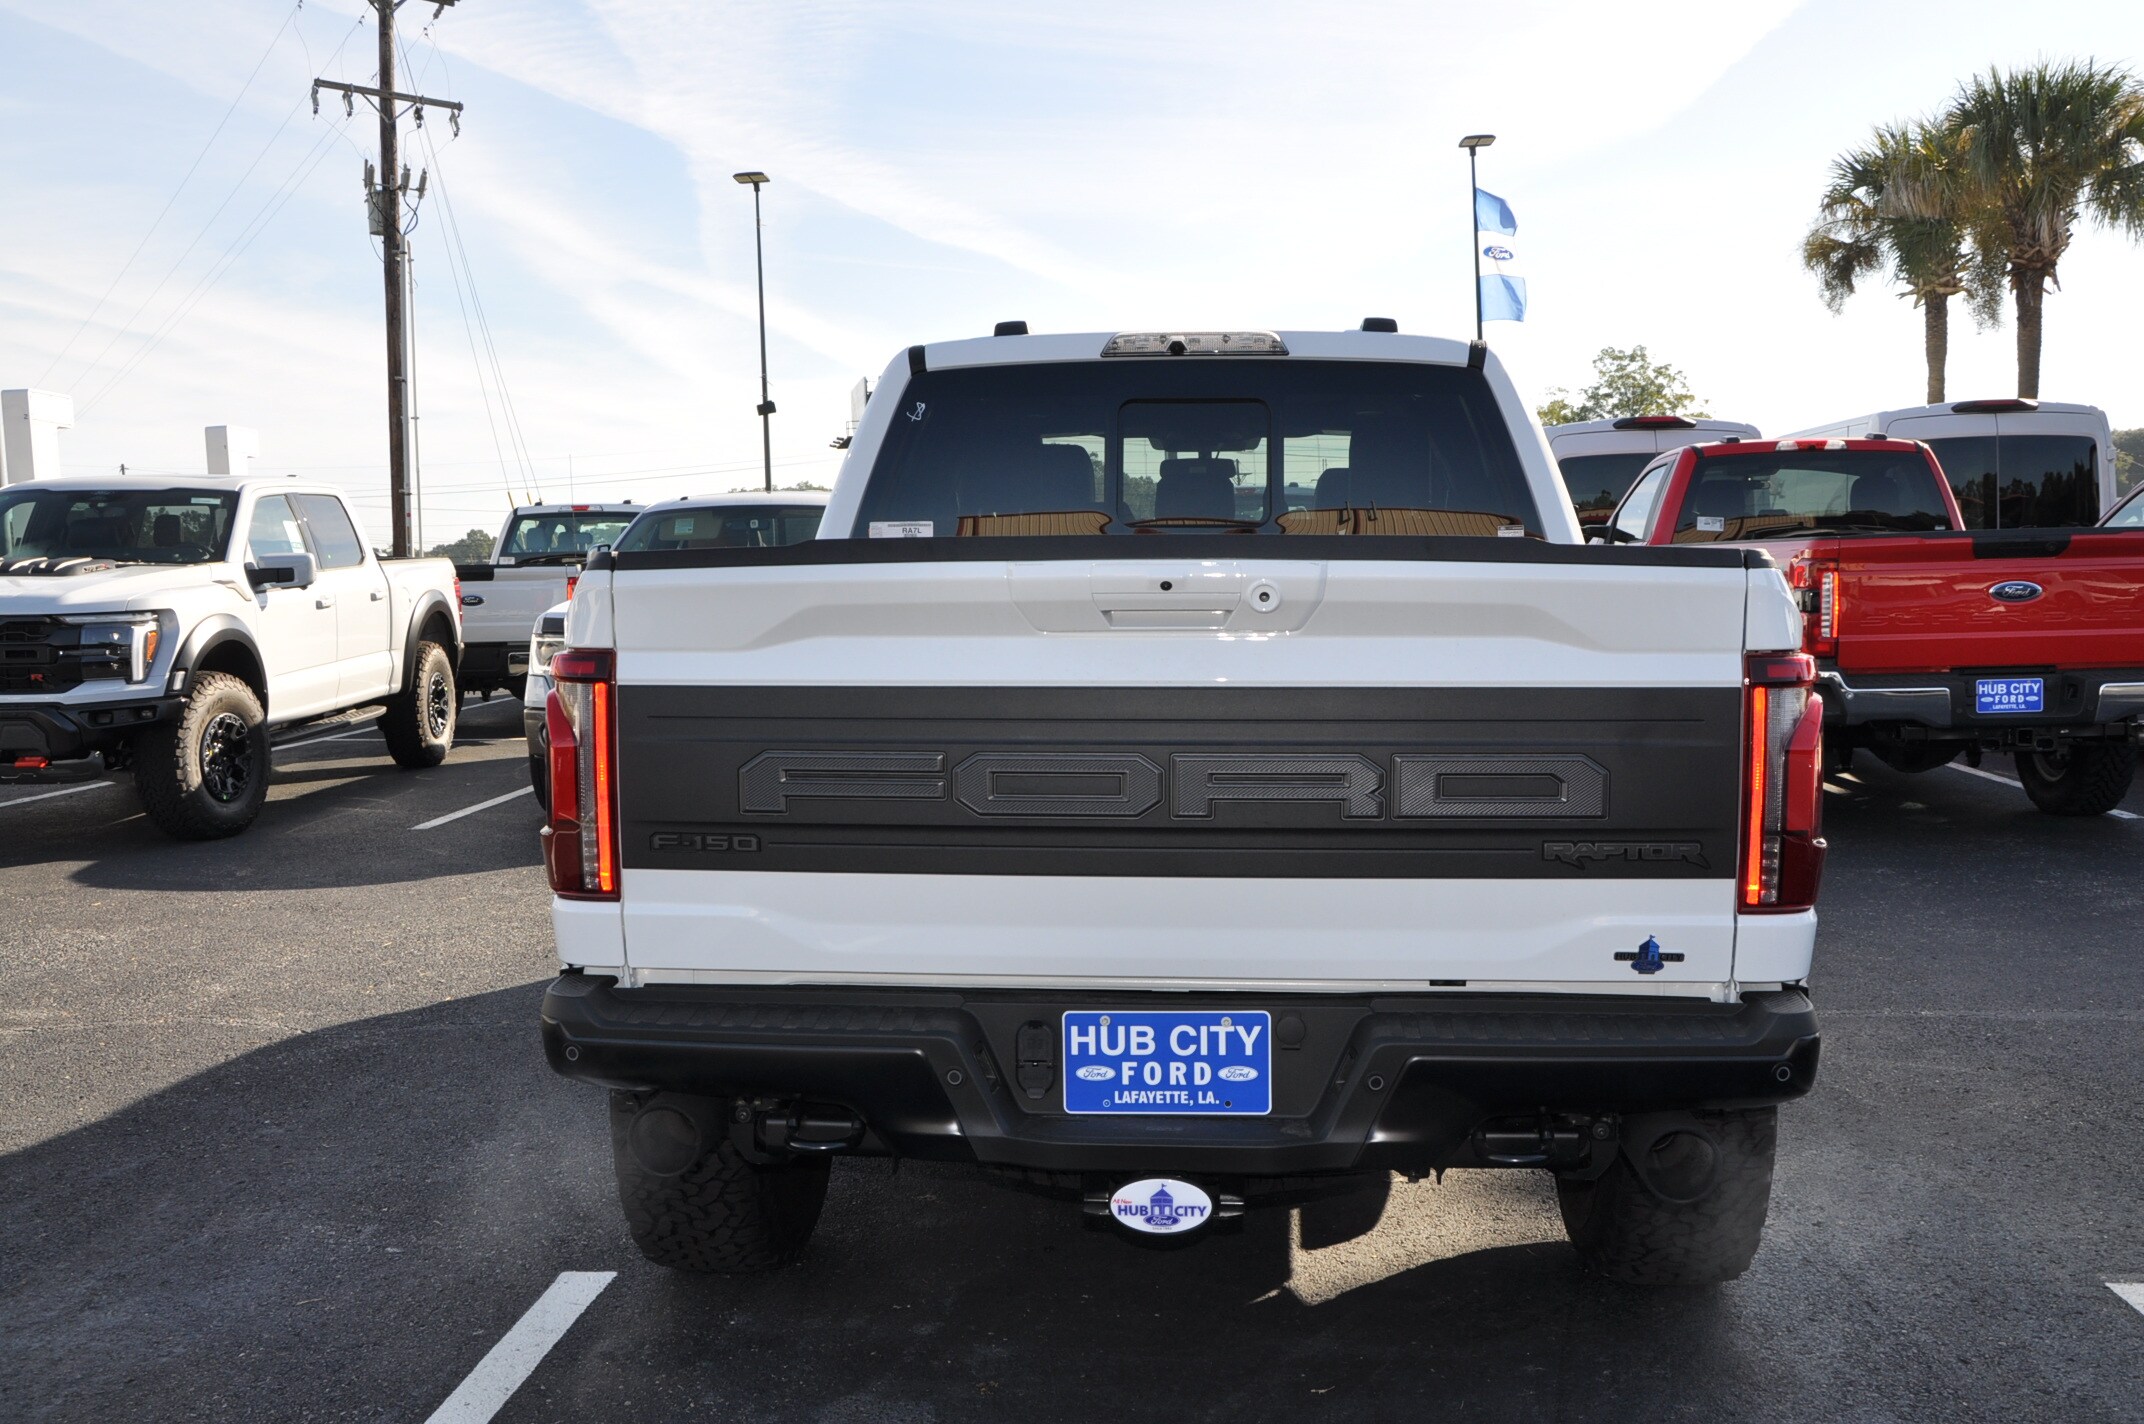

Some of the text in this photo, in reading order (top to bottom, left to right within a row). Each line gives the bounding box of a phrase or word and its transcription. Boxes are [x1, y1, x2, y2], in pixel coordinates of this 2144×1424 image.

[1489, 247, 1510, 259] Ford
[2004, 585, 2030, 597] Ford
[1978, 682, 2040, 695] HUB CITY
[1994, 694, 2025, 704] FORD
[739, 750, 1609, 820] FORD
[652, 834, 758, 851] F-150
[1543, 841, 1711, 869] RAPTOR
[1070, 1025, 1262, 1056] HUB CITY
[1083, 1067, 1109, 1079] Ford
[1121, 1061, 1212, 1085] FORD
[1225, 1067, 1251, 1079] Ford
[1114, 1091, 1220, 1106] LAFAYETTE, LA.
[1118, 1206, 1207, 1217] HUB CITY
[1150, 1216, 1173, 1225] Ford
